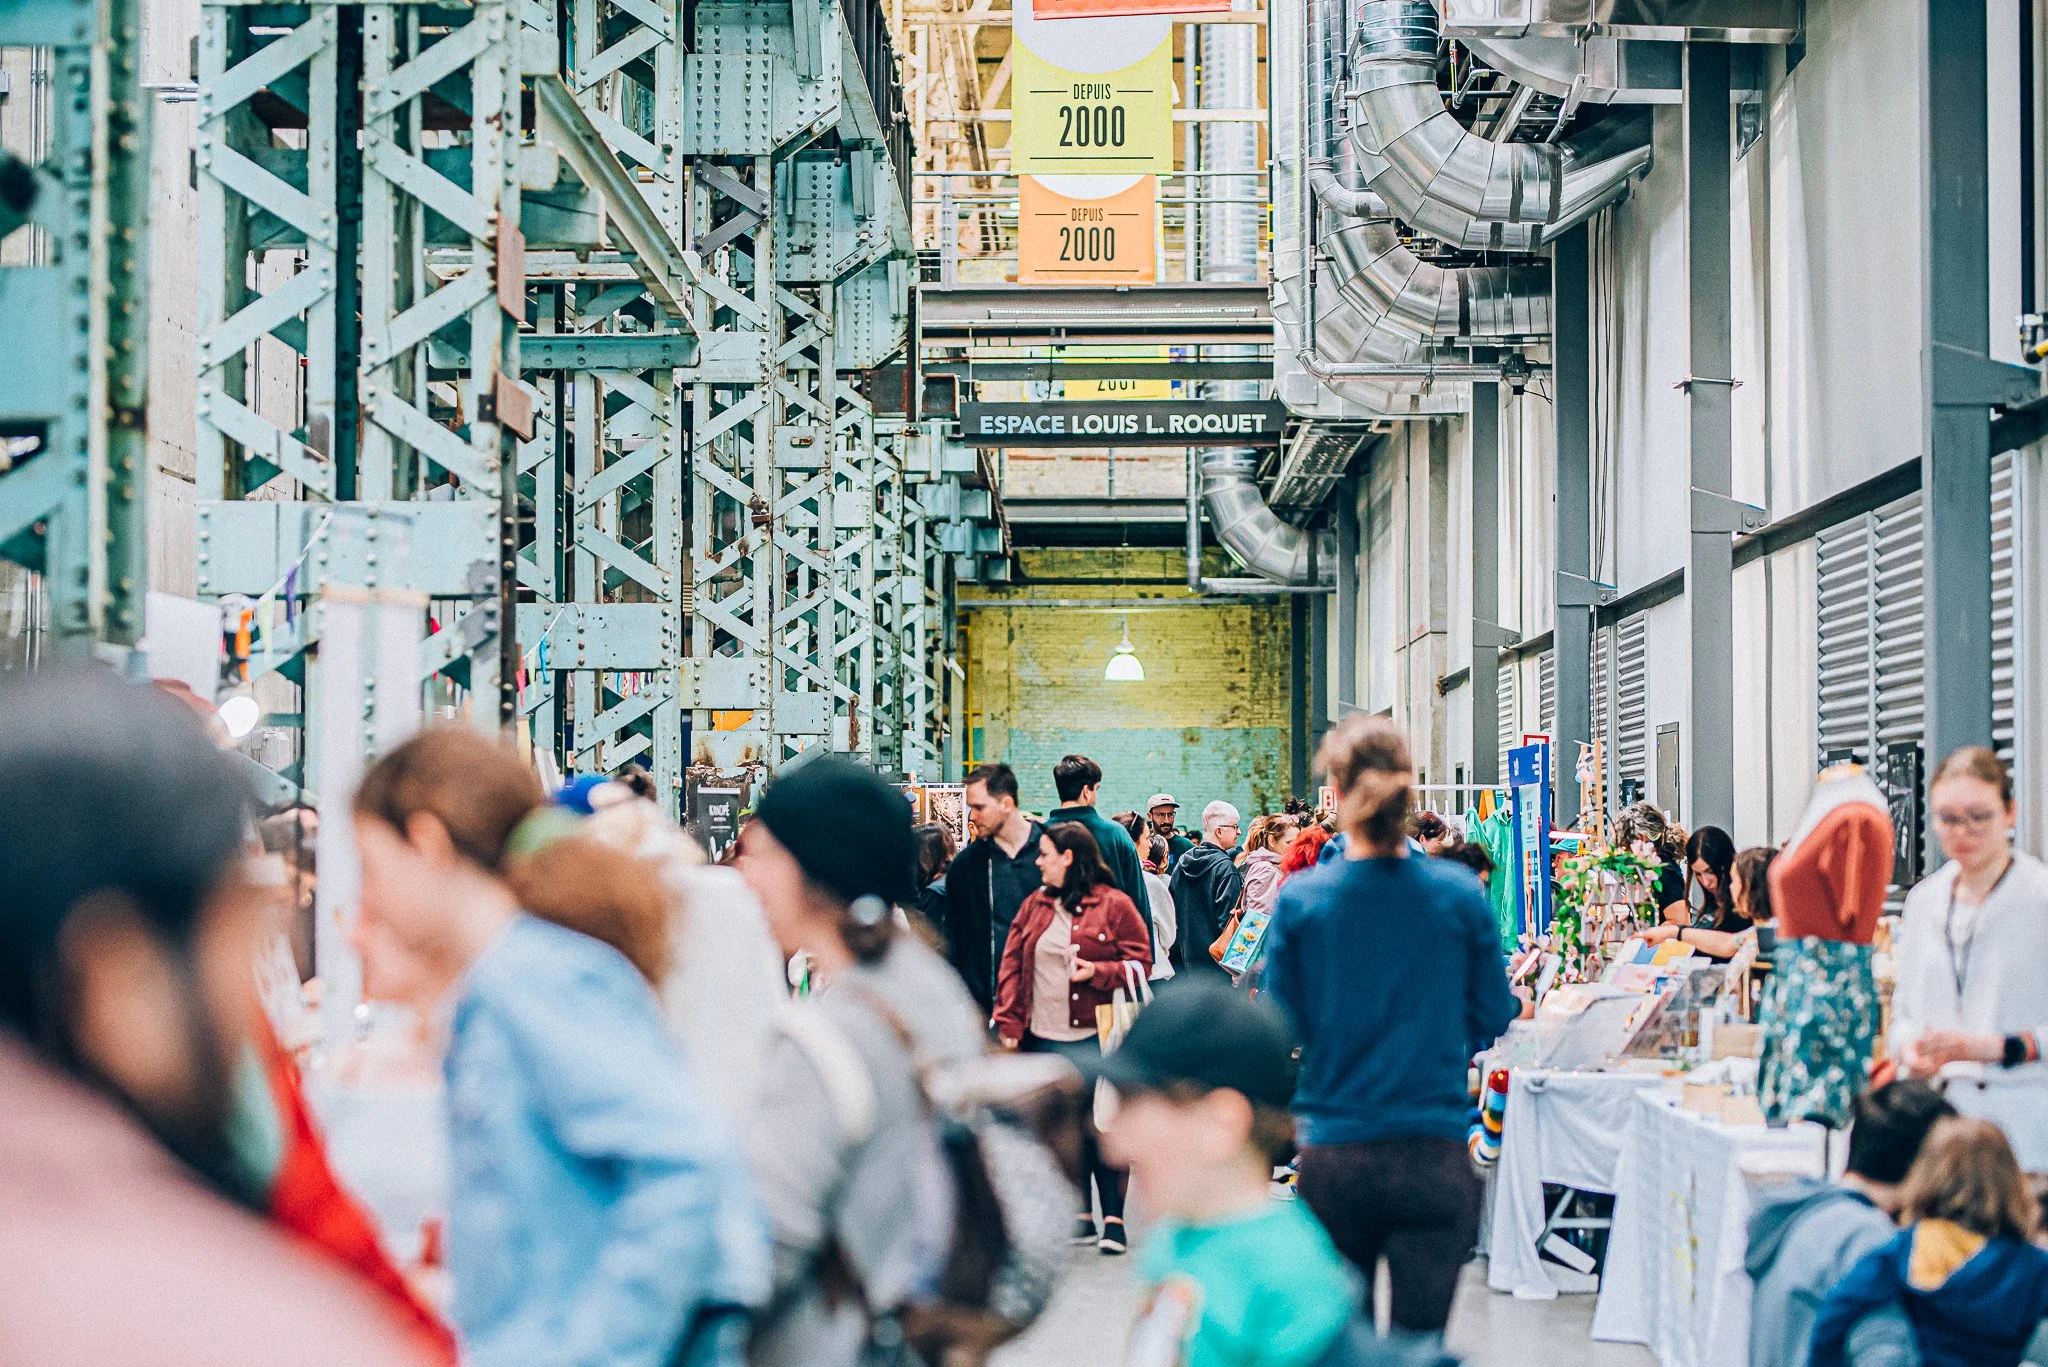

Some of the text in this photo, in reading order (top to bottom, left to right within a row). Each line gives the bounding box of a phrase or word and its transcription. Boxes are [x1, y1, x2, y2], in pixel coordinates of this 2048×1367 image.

[1073, 83, 1111, 100] DEPUIS
[1059, 105, 1125, 147] 2000
[1071, 207, 1104, 222] DEPUIS
[1059, 226, 1115, 262] 2000
[980, 413, 1267, 434] ESPACE LOUIS L. ROQUET
